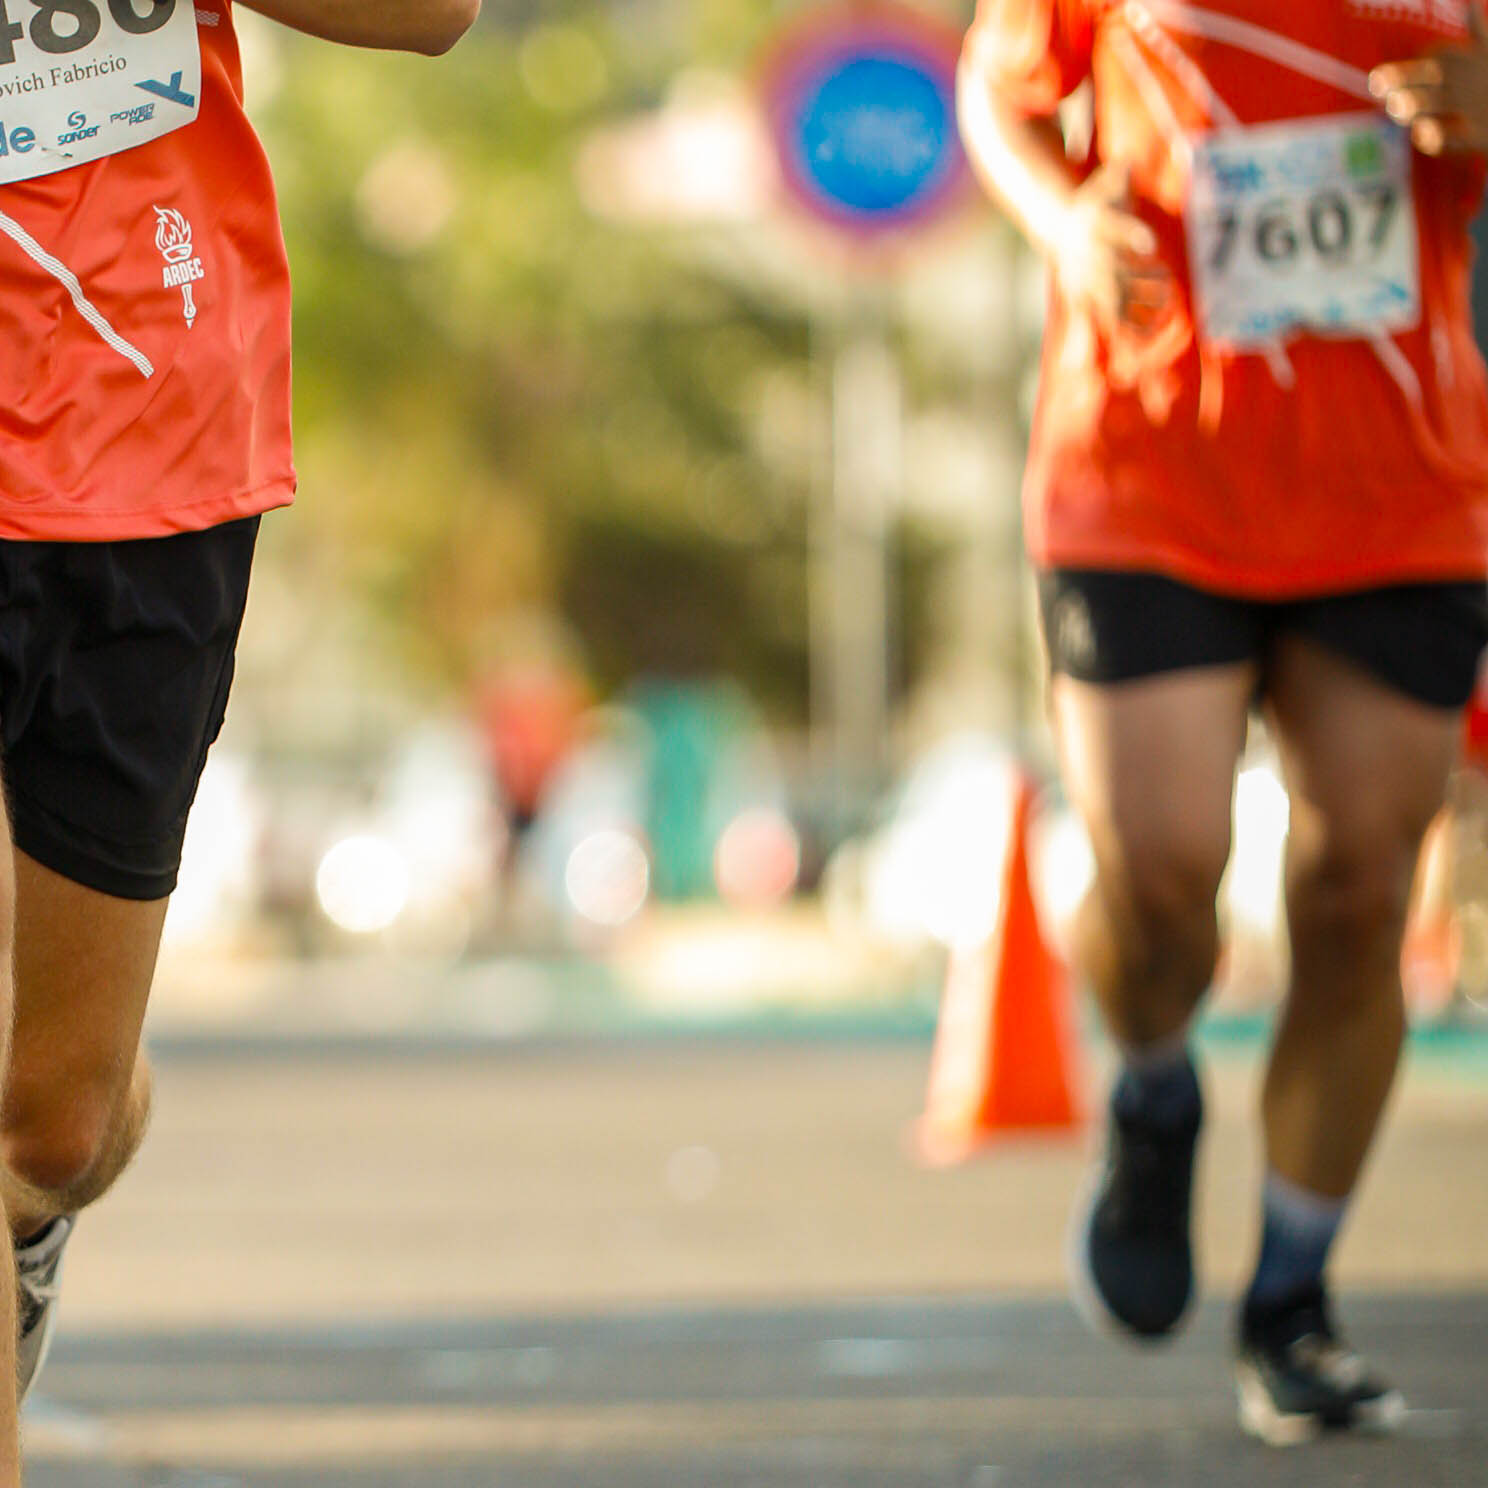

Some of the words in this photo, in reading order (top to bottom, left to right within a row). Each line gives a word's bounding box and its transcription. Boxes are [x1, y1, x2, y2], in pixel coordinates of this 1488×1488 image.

[51, 55, 128, 86] Fabricio
[1208, 184, 1402, 273] 7607
[162, 258, 204, 288] ARDEC
